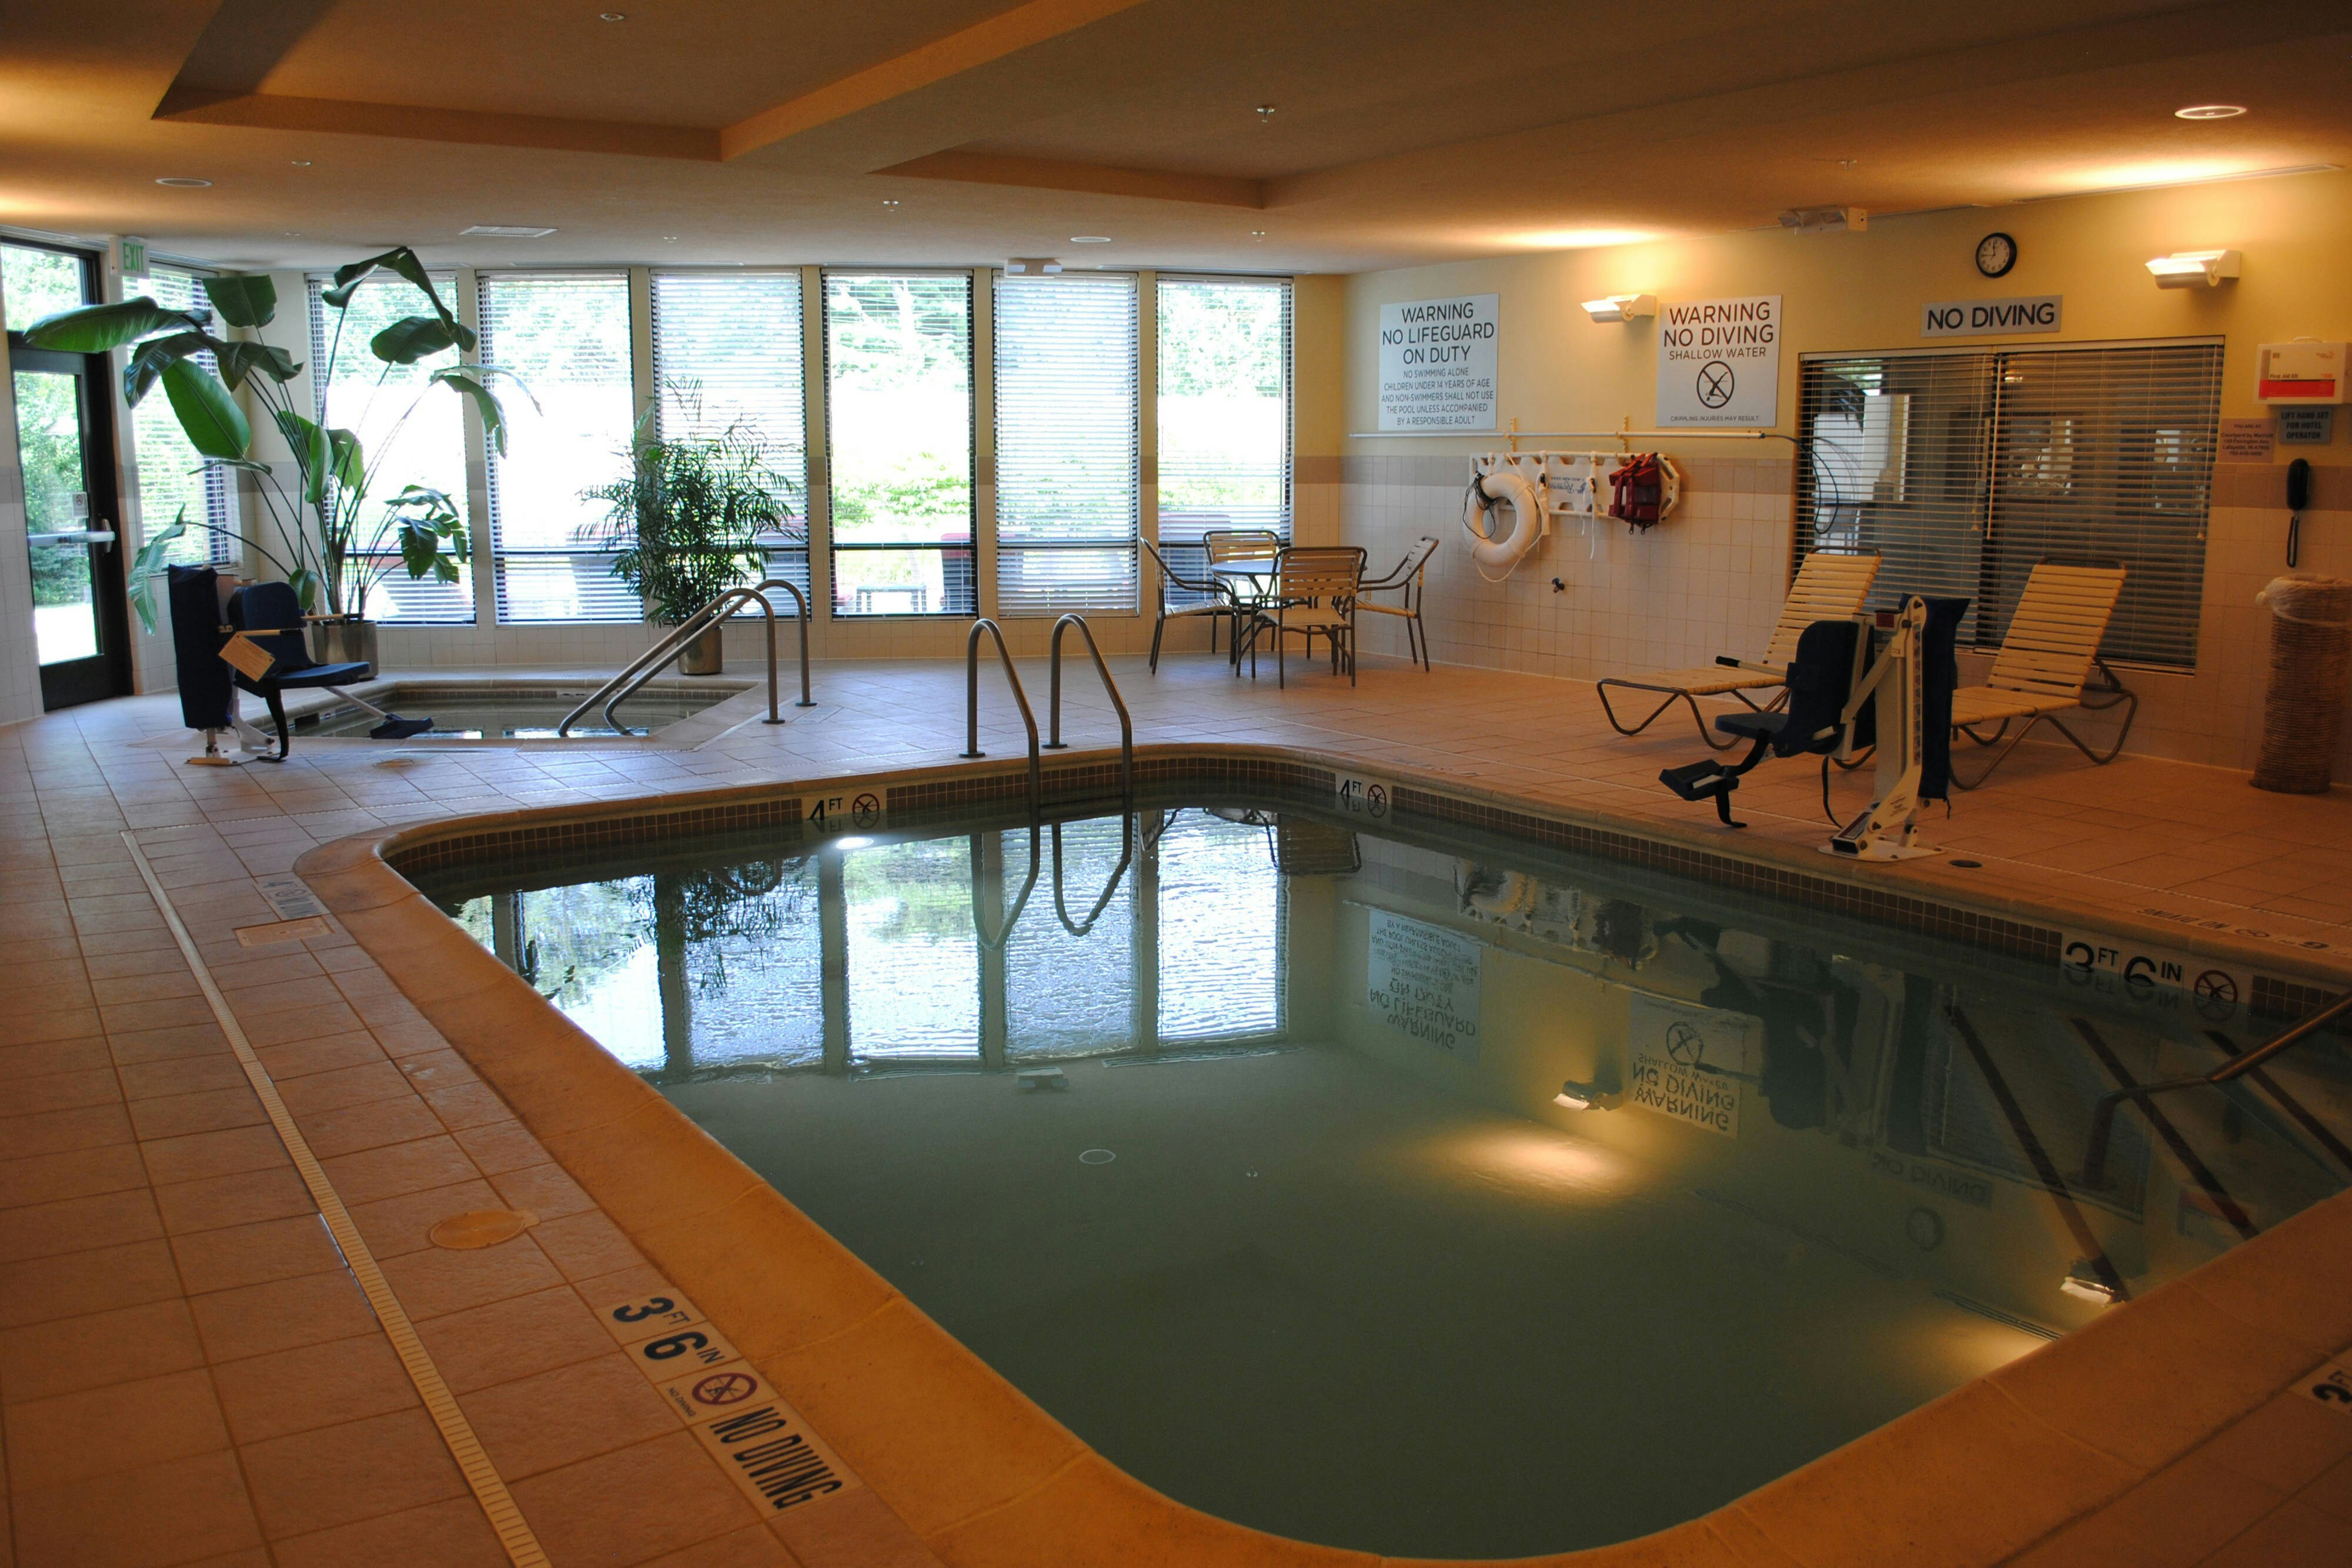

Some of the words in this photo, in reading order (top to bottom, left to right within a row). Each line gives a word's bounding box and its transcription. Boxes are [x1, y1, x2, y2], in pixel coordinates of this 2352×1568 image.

[122, 242, 144, 273] EXIT
[1402, 302, 1474, 323] WARNING
[1669, 302, 1770, 325] WARNING
[1927, 308, 1963, 330] NO
[1972, 303, 2054, 327] DIVING
[1382, 329, 1404, 345] NO
[1409, 323, 1494, 343] LIFEGUARD
[1664, 329, 1693, 347] NO
[1702, 324, 1773, 345] DIVING
[1403, 348, 1424, 365] ON
[1430, 346, 1471, 363] DUTY
[1669, 349, 1723, 360] SHALLOW
[1726, 347, 1766, 358] WATER
[1414, 369, 1446, 378] SWIMMING
[1448, 367, 1469, 376] ALONE
[1384, 382, 1414, 391] CHILDREN
[1415, 381, 1435, 390] UNDER
[1444, 380, 1465, 389] YEARS
[1466, 379, 1475, 388] OF
[1477, 379, 1490, 387] AGE
[1395, 392, 1443, 402] NON-SWIMMERS
[1445, 392, 1464, 400] SHALL
[1466, 391, 1480, 400] NOT
[1481, 390, 1494, 399] USE
[1387, 406, 1397, 414] THE
[1399, 405, 1415, 414] POOL
[1417, 404, 1439, 413] UNLESS
[1441, 403, 1488, 413] ACCOMPANIED
[1412, 416, 1453, 425] RESPONSIBLE
[1454, 415, 1475, 424] ADULT
[1352, 780, 1362, 794] FT
[829, 797, 843, 811] FT
[2097, 947, 2119, 967] FT
[2124, 956, 2157, 987] 6
[2161, 961, 2182, 982] IN
[613, 1297, 674, 1323] 3
[663, 1310, 691, 1325] FT
[643, 1331, 709, 1360] 6
[696, 1347, 725, 1364] IN
[676, 1396, 697, 1417] DIVING
[709, 1406, 787, 1444] NO
[733, 1433, 843, 1510] DIVING
